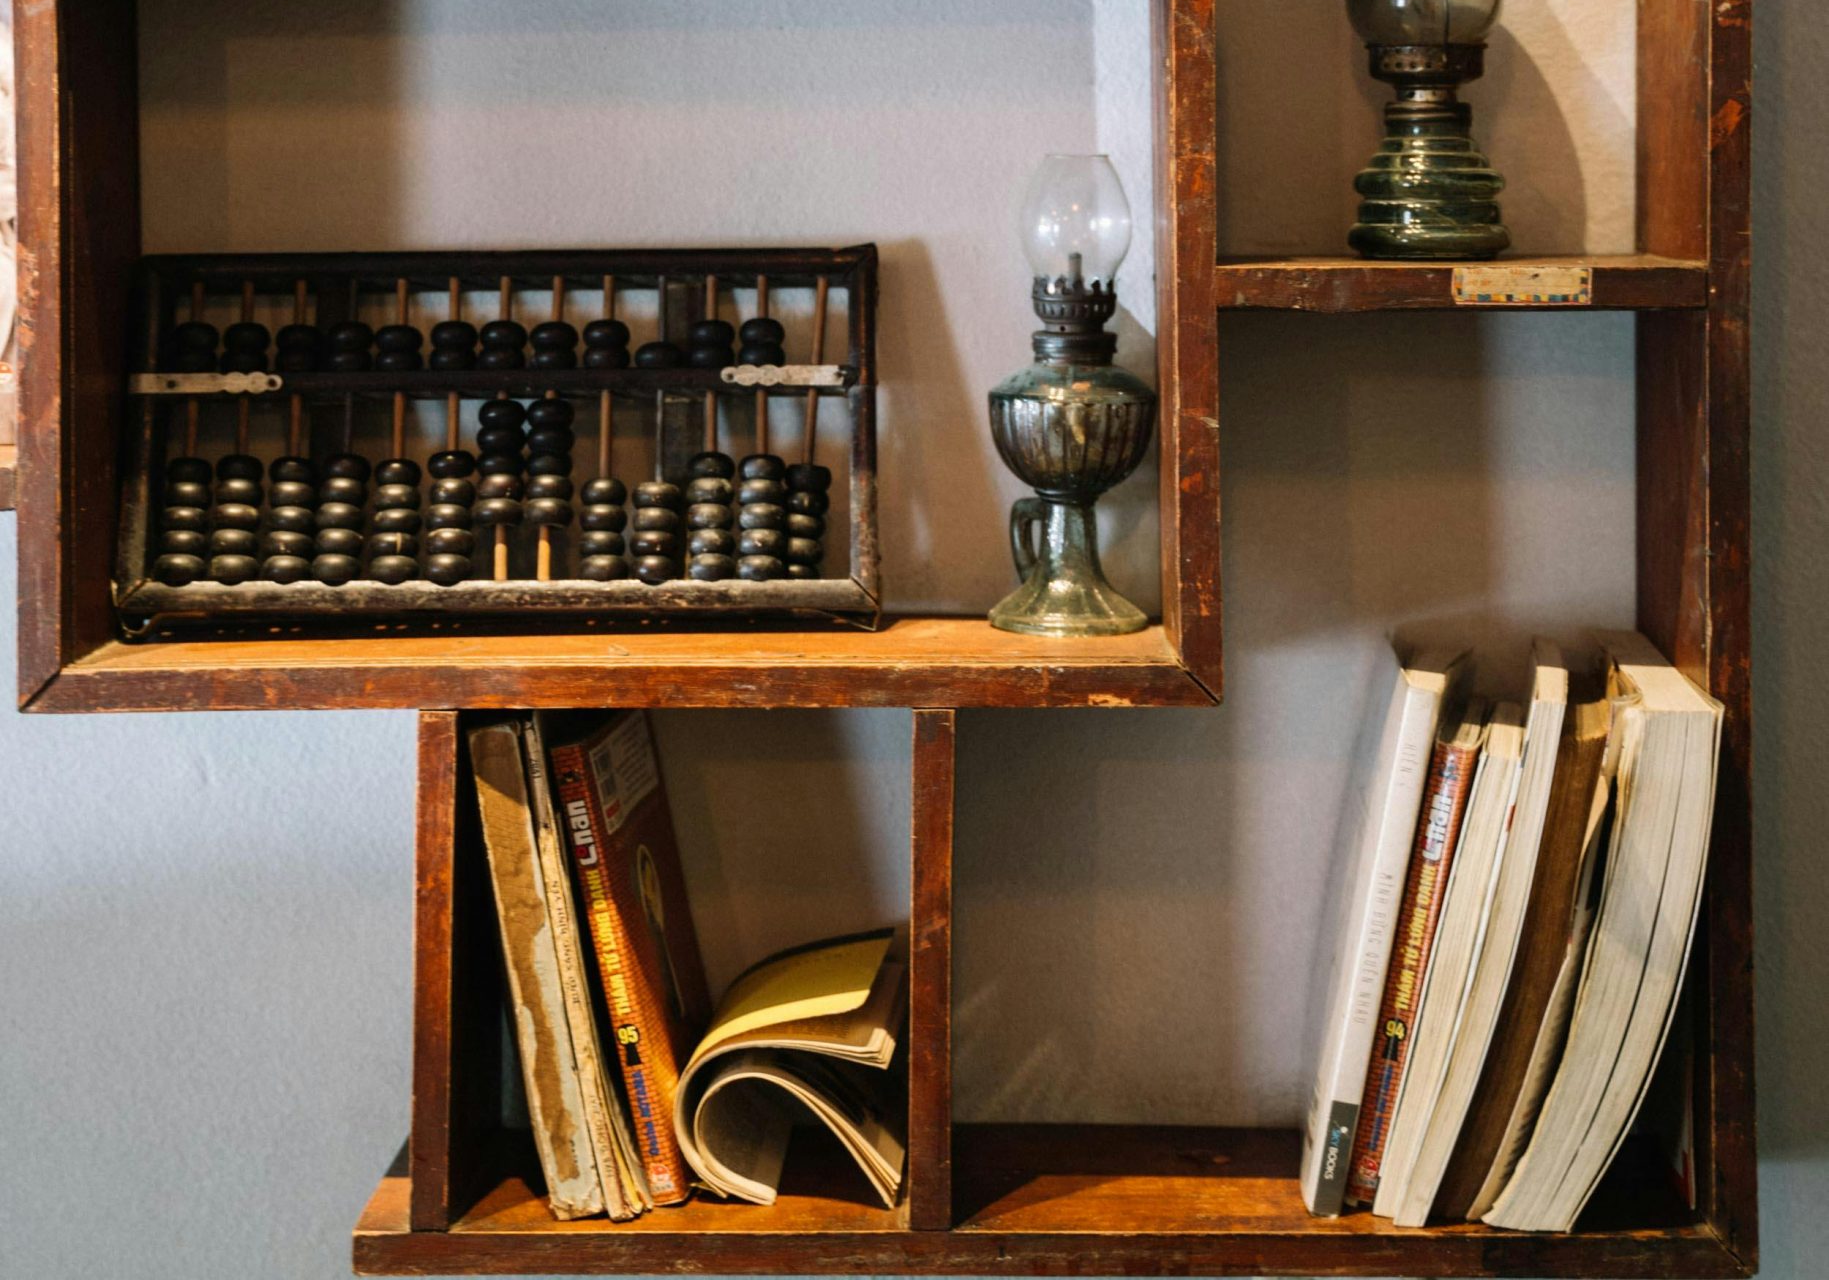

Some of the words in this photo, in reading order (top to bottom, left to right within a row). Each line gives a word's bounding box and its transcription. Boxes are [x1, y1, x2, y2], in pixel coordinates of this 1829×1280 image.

[586, 869, 608, 911] DANH
[1416, 863, 1438, 907] DANH
[617, 1025, 639, 1046] 95
[1385, 1019, 1406, 1040] 94
